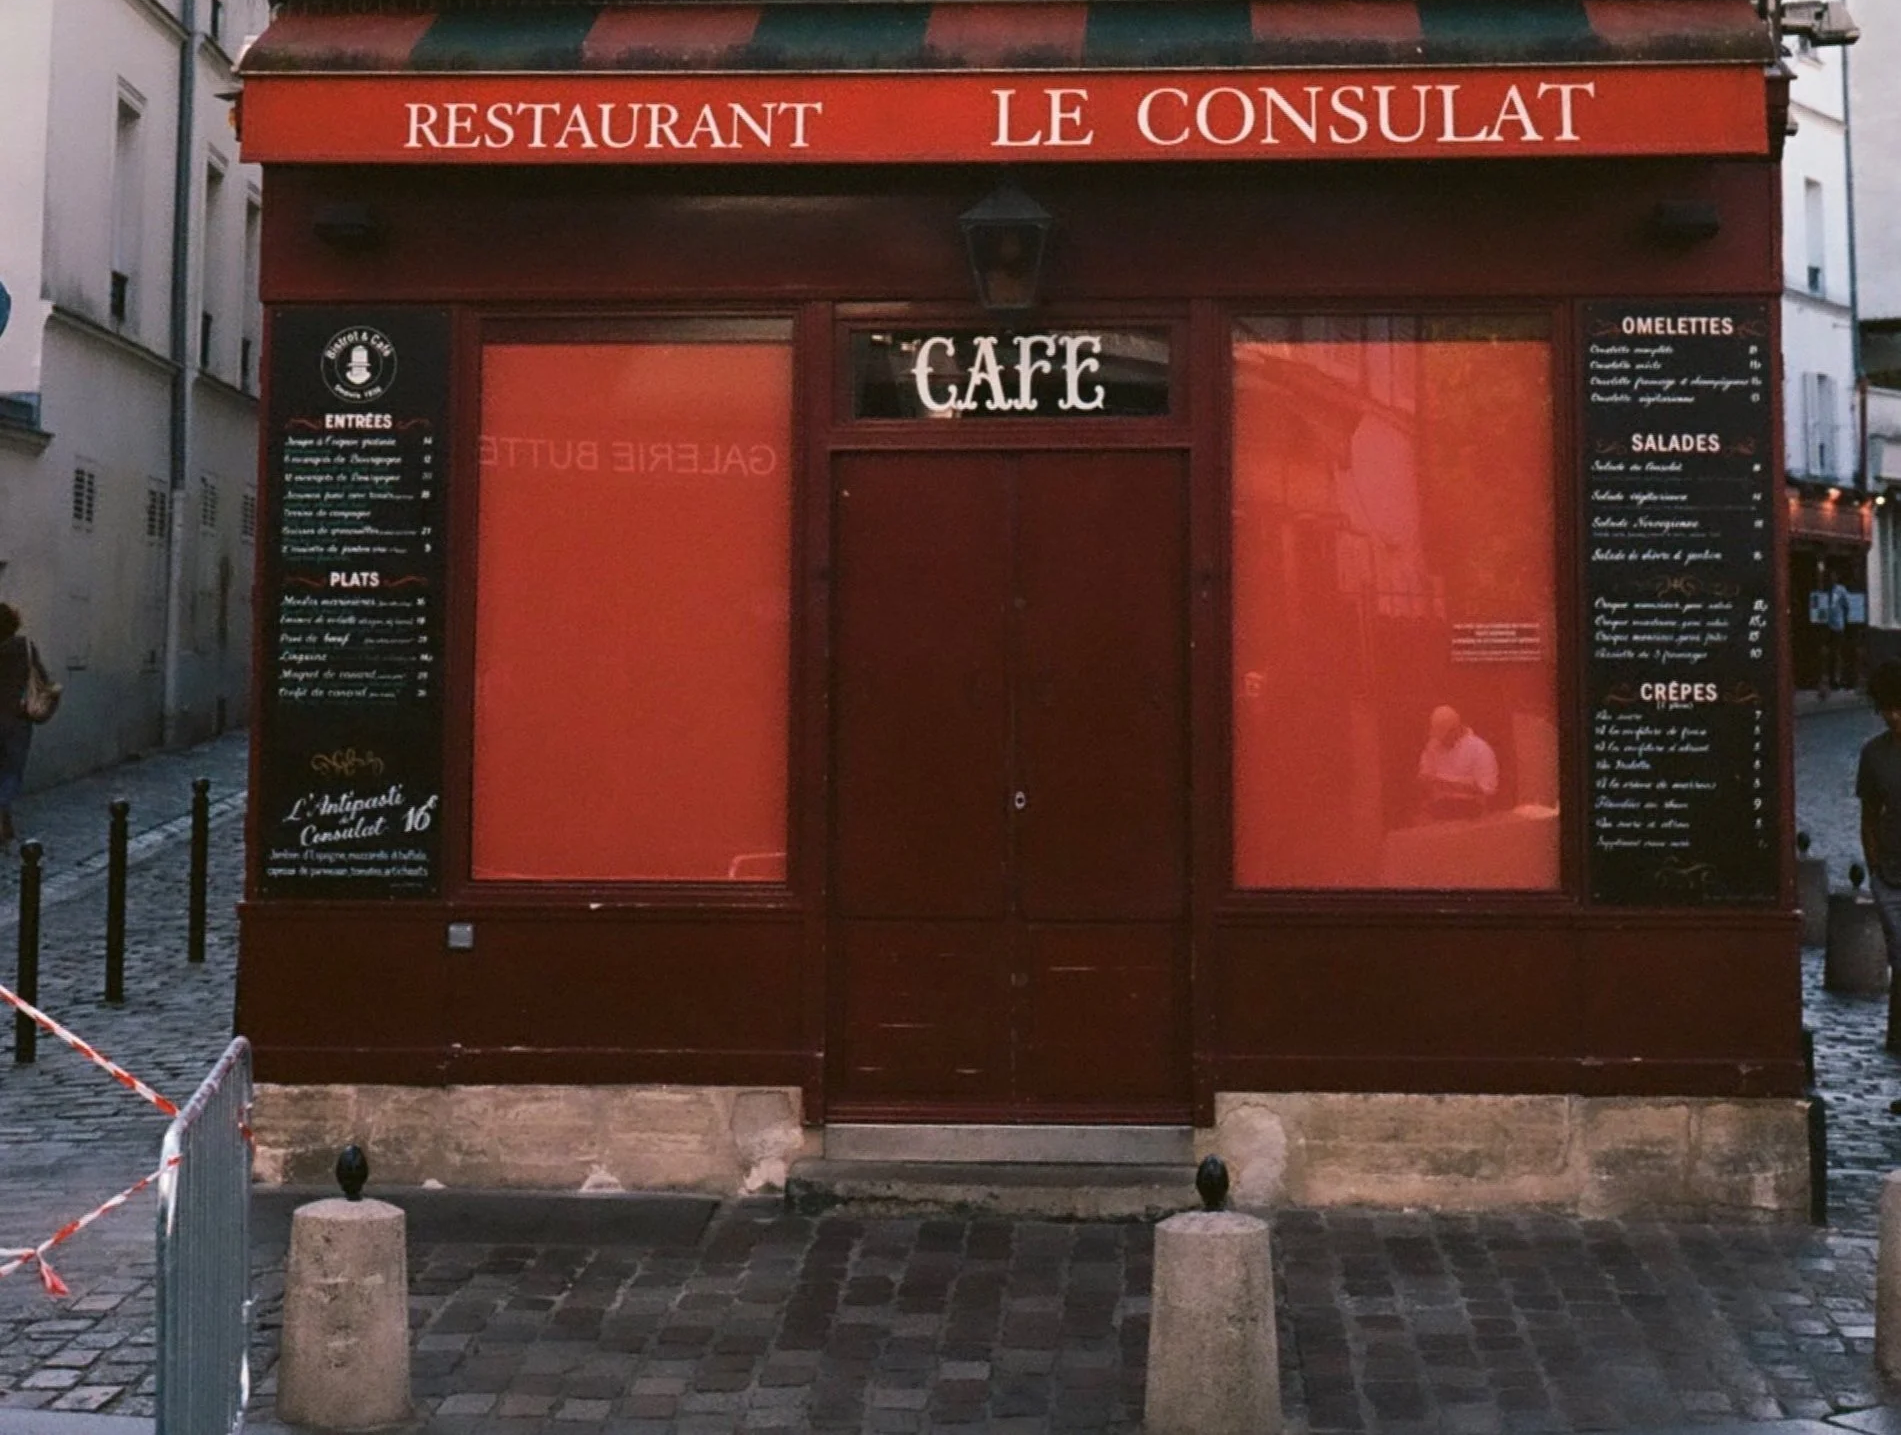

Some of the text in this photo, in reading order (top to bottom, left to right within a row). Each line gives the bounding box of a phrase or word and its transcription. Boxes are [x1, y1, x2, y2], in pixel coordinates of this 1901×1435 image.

[404, 101, 823, 149] RESTAURANT
[991, 82, 1595, 147] LE CONSULAT
[1622, 316, 1733, 335] OMELETTES
[912, 335, 1105, 411] CAFE
[325, 412, 393, 429] ENTRÉES
[1631, 433, 1721, 452] SALADES
[330, 571, 380, 587] PLATS
[1640, 679, 1718, 701] CRÊPES
[300, 815, 389, 847] Consulat
